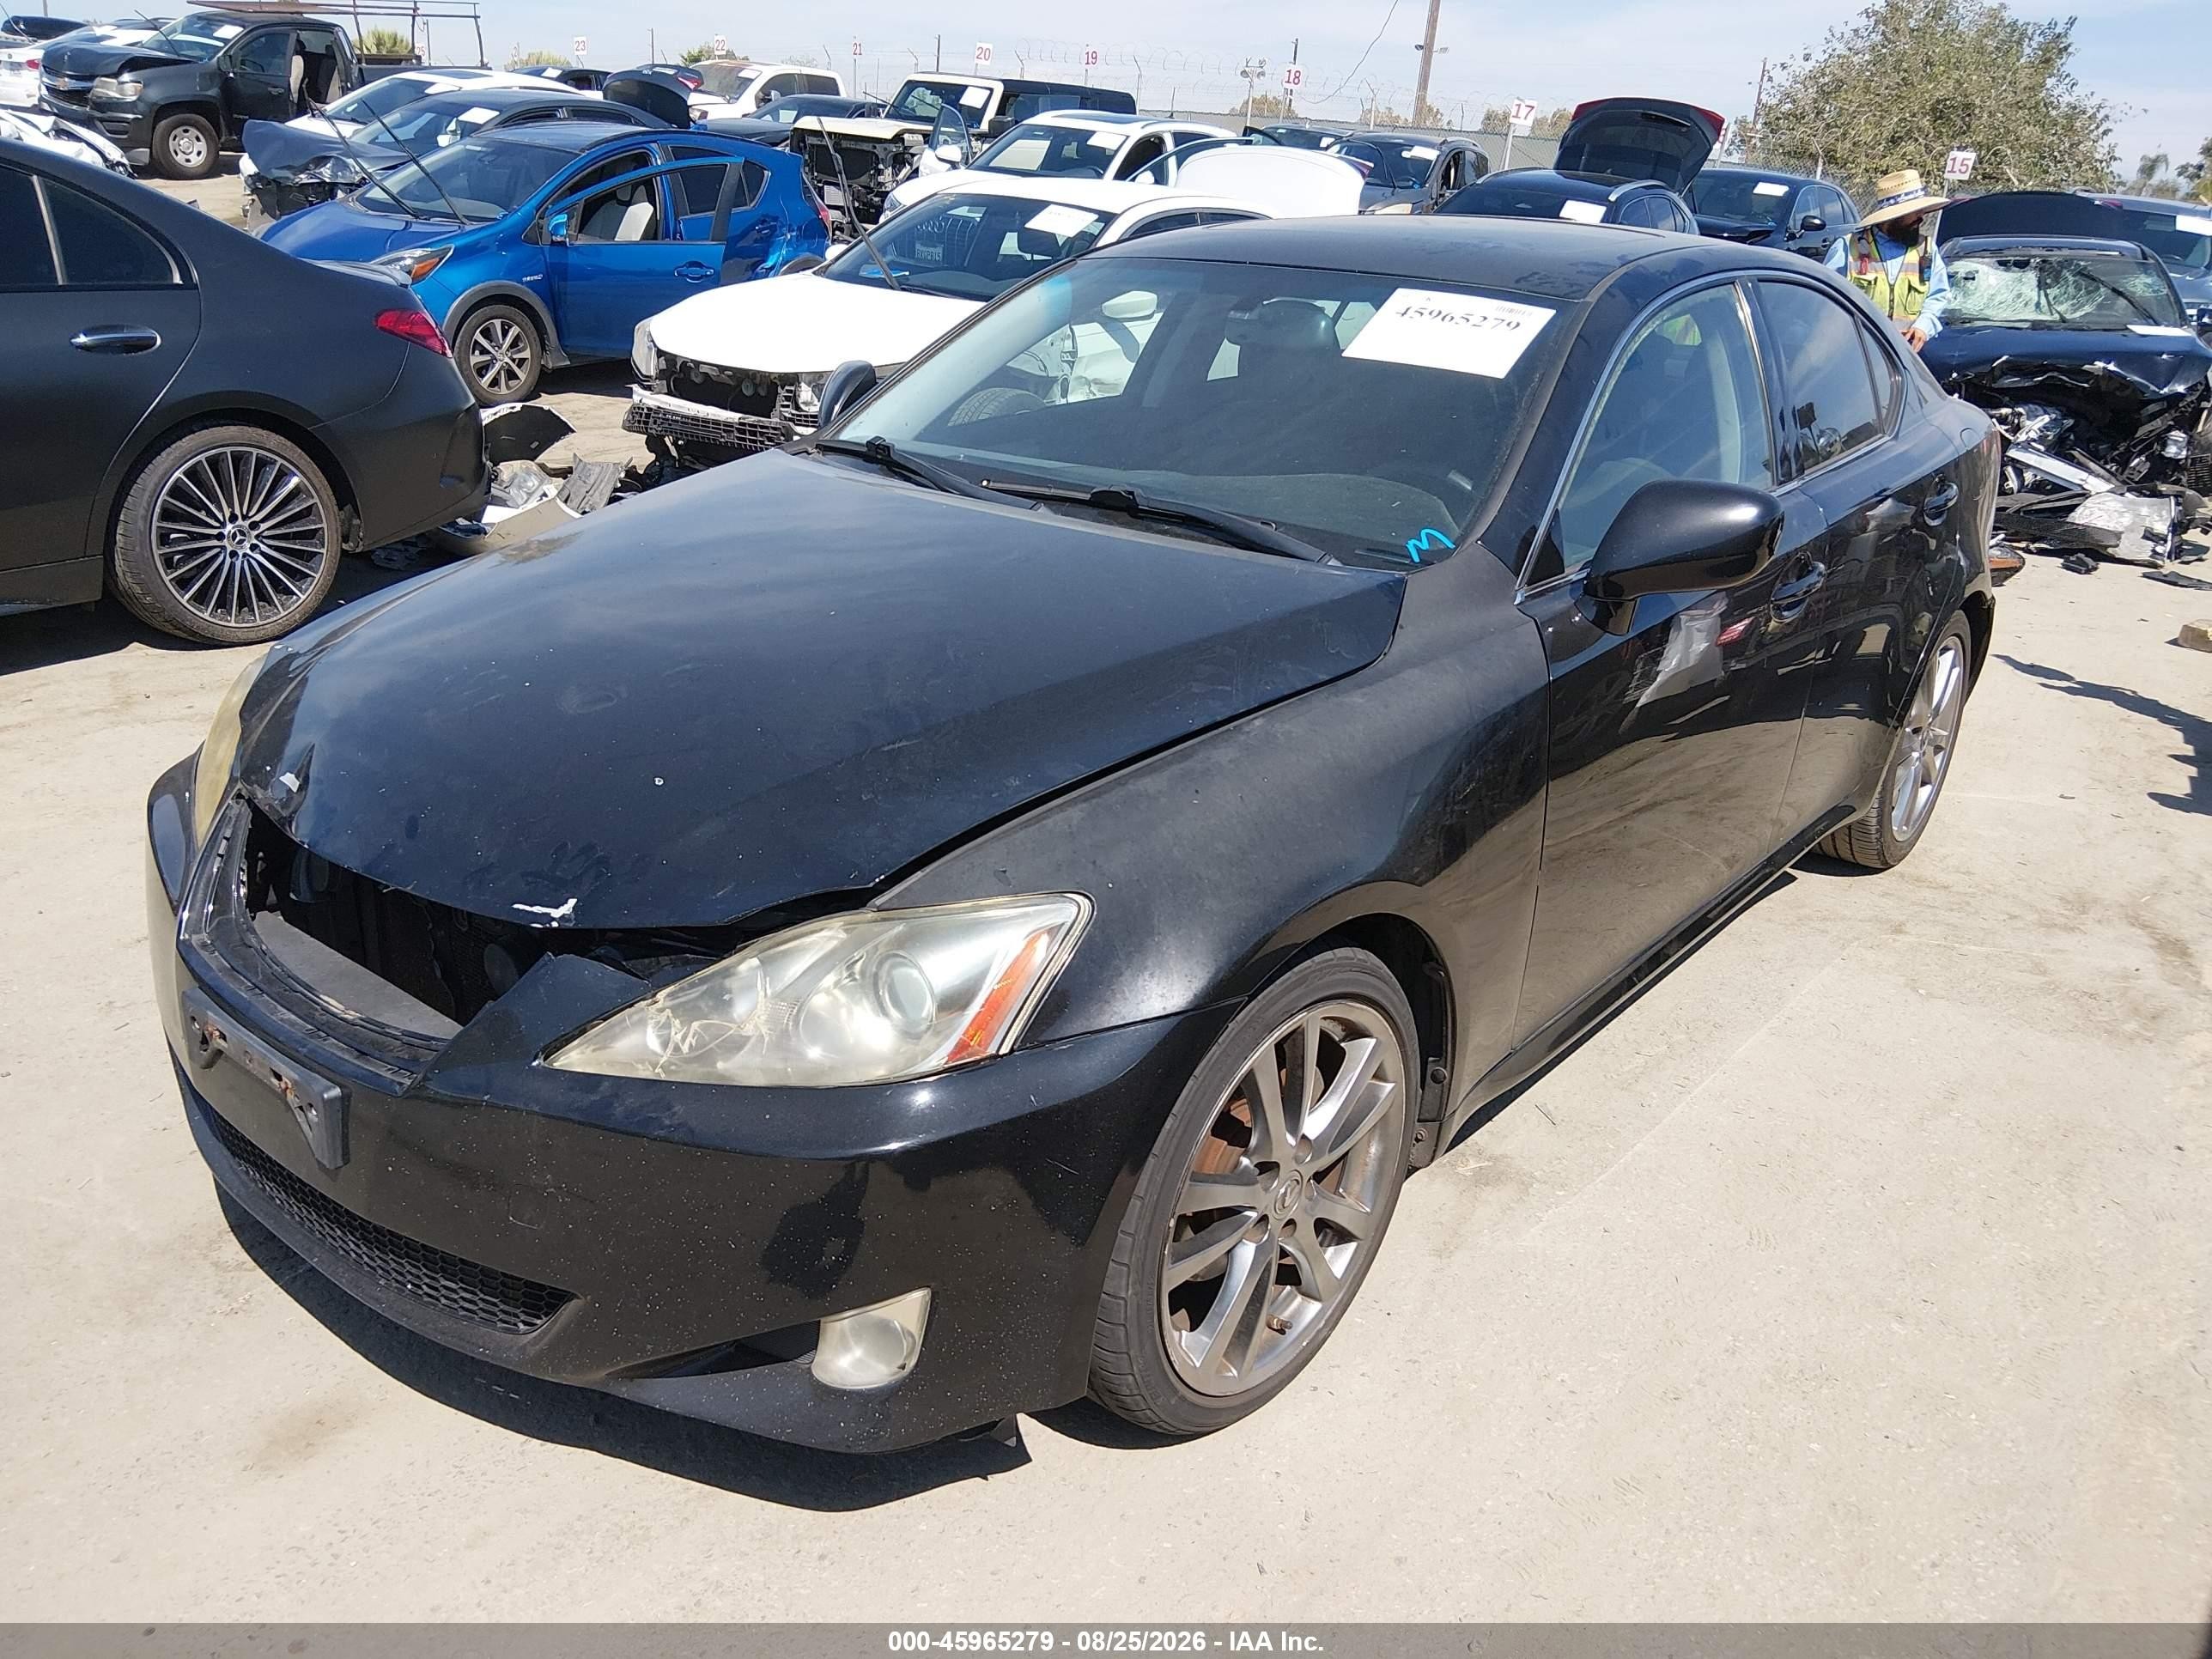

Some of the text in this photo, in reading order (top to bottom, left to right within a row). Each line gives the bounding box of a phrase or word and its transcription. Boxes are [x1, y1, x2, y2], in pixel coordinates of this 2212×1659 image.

[574, 40, 586, 52] 23
[715, 40, 726, 52] 22
[853, 42, 863, 56] 21
[975, 46, 991, 62] 20
[1085, 51, 1098, 65] 19
[1284, 69, 1302, 86] 18
[1511, 103, 1535, 120] 17
[1947, 156, 1972, 174] 15
[1395, 306, 1522, 331] 45965279
